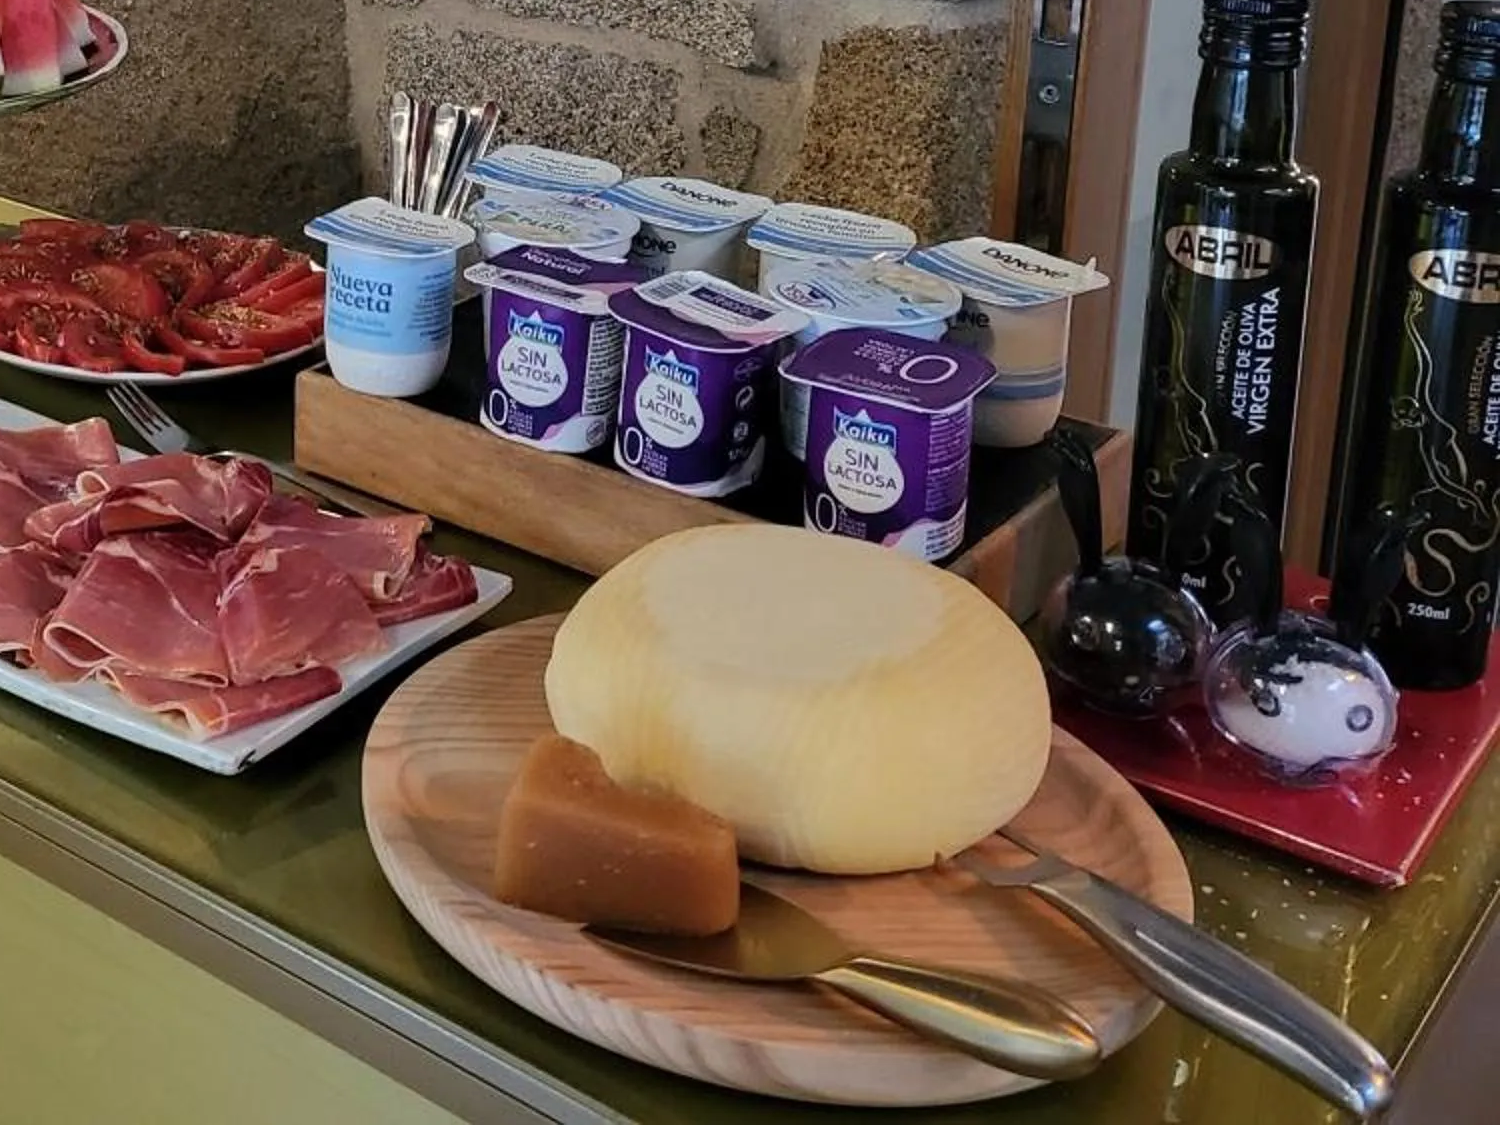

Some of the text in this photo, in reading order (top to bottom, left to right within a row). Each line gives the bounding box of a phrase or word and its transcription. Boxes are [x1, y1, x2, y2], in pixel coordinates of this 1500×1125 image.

[1175, 230, 1271, 269] ABRIL
[330, 263, 394, 296] Nueva
[1422, 256, 1500, 290] ABR
[330, 286, 391, 314] receta
[512, 316, 558, 343] Kaiku
[517, 346, 548, 368] SIN
[649, 355, 694, 385] Kaiku
[1231, 302, 1257, 419] ACEITE DE OLIVA
[1246, 287, 1281, 435] VIRGEN EXTRA
[501, 360, 563, 386] LACTOSA
[639, 394, 697, 428] LACTOSA
[656, 384, 683, 409] SIN
[837, 416, 891, 445] Kaiku
[1483, 395, 1500, 445] ACEITE
[845, 448, 880, 472] SIN
[827, 461, 898, 490] LACTOSA
[1407, 602, 1451, 620] 250ml
